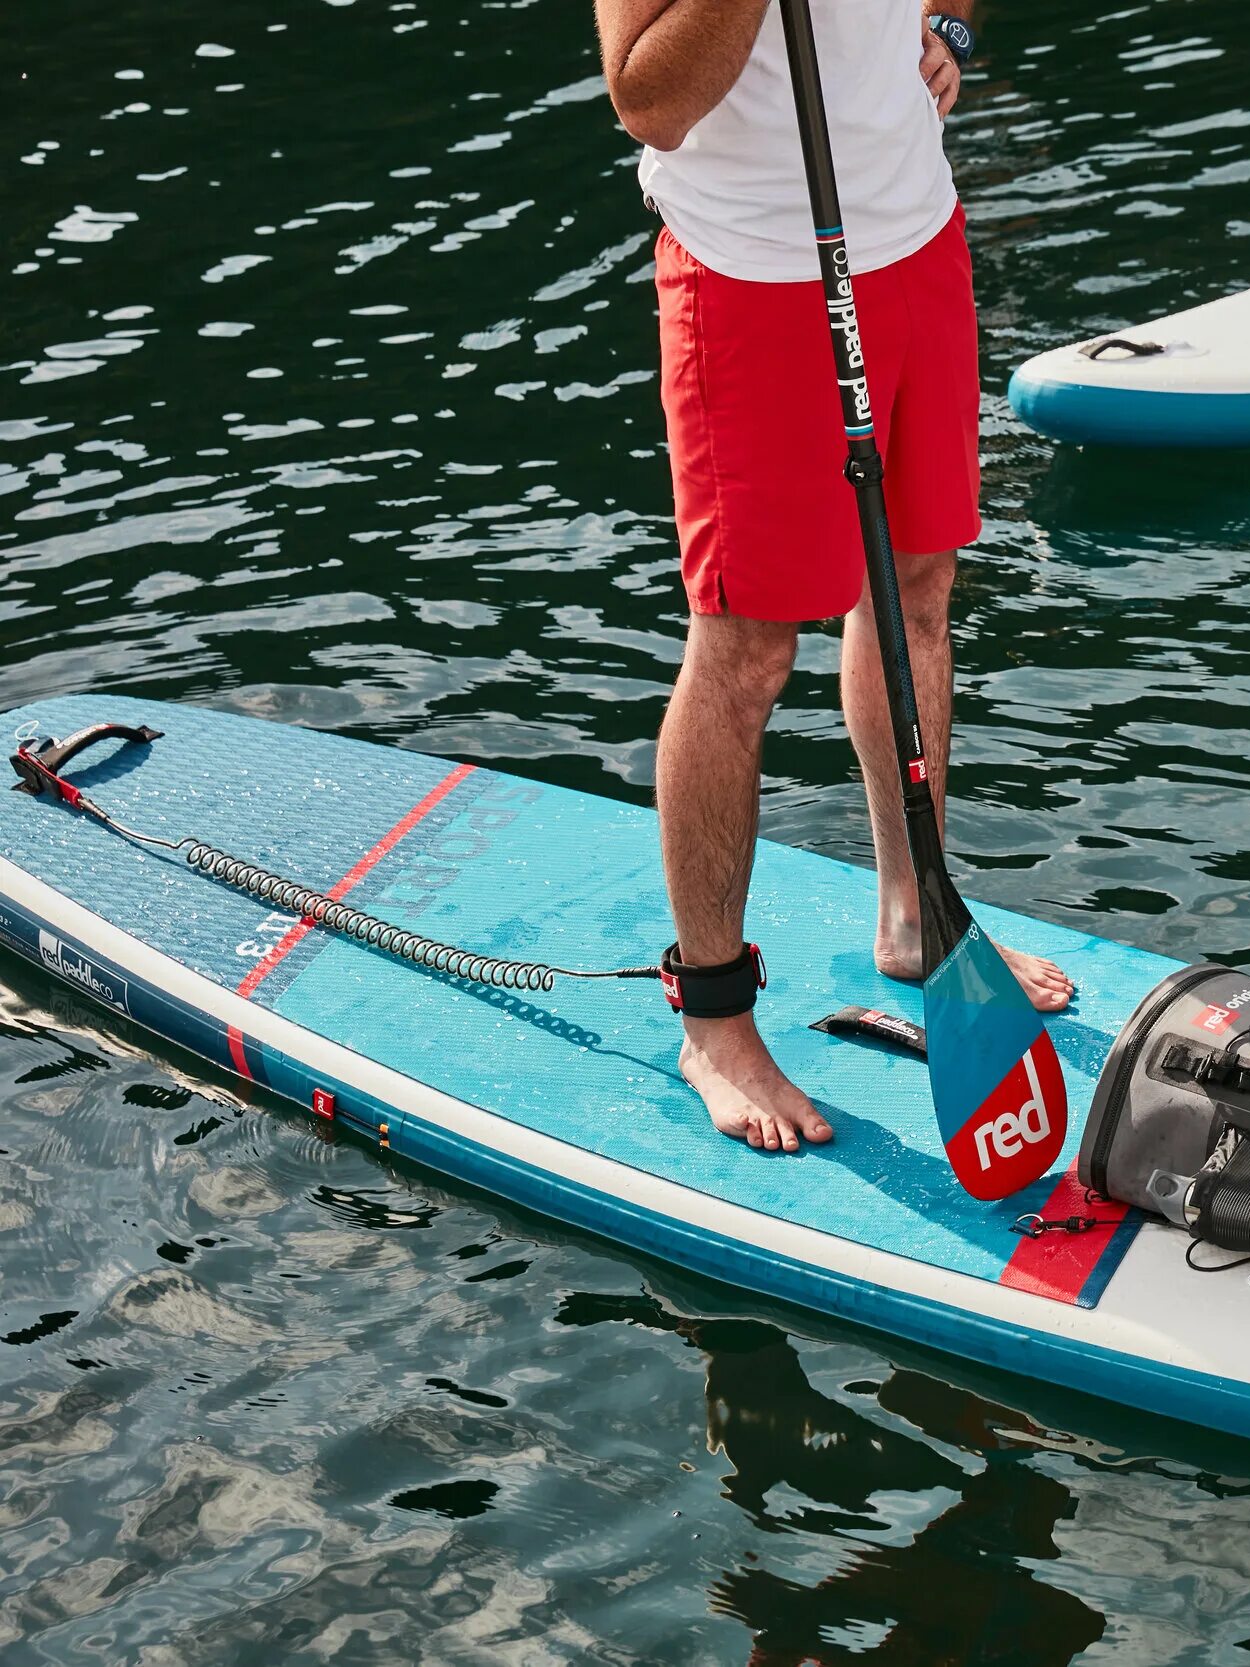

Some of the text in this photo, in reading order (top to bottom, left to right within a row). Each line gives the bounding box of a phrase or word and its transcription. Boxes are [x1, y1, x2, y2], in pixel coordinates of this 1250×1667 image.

[837, 376, 871, 420] red
[909, 760, 927, 779] red
[373, 781, 544, 920] SPORT
[42, 940, 60, 967] red
[63, 959, 114, 1000] paddleco
[928, 961, 952, 987] STRUCTURAL
[663, 977, 679, 999] red
[1203, 1004, 1231, 1030] red
[317, 1095, 332, 1116] red
[974, 1048, 1051, 1171] red
